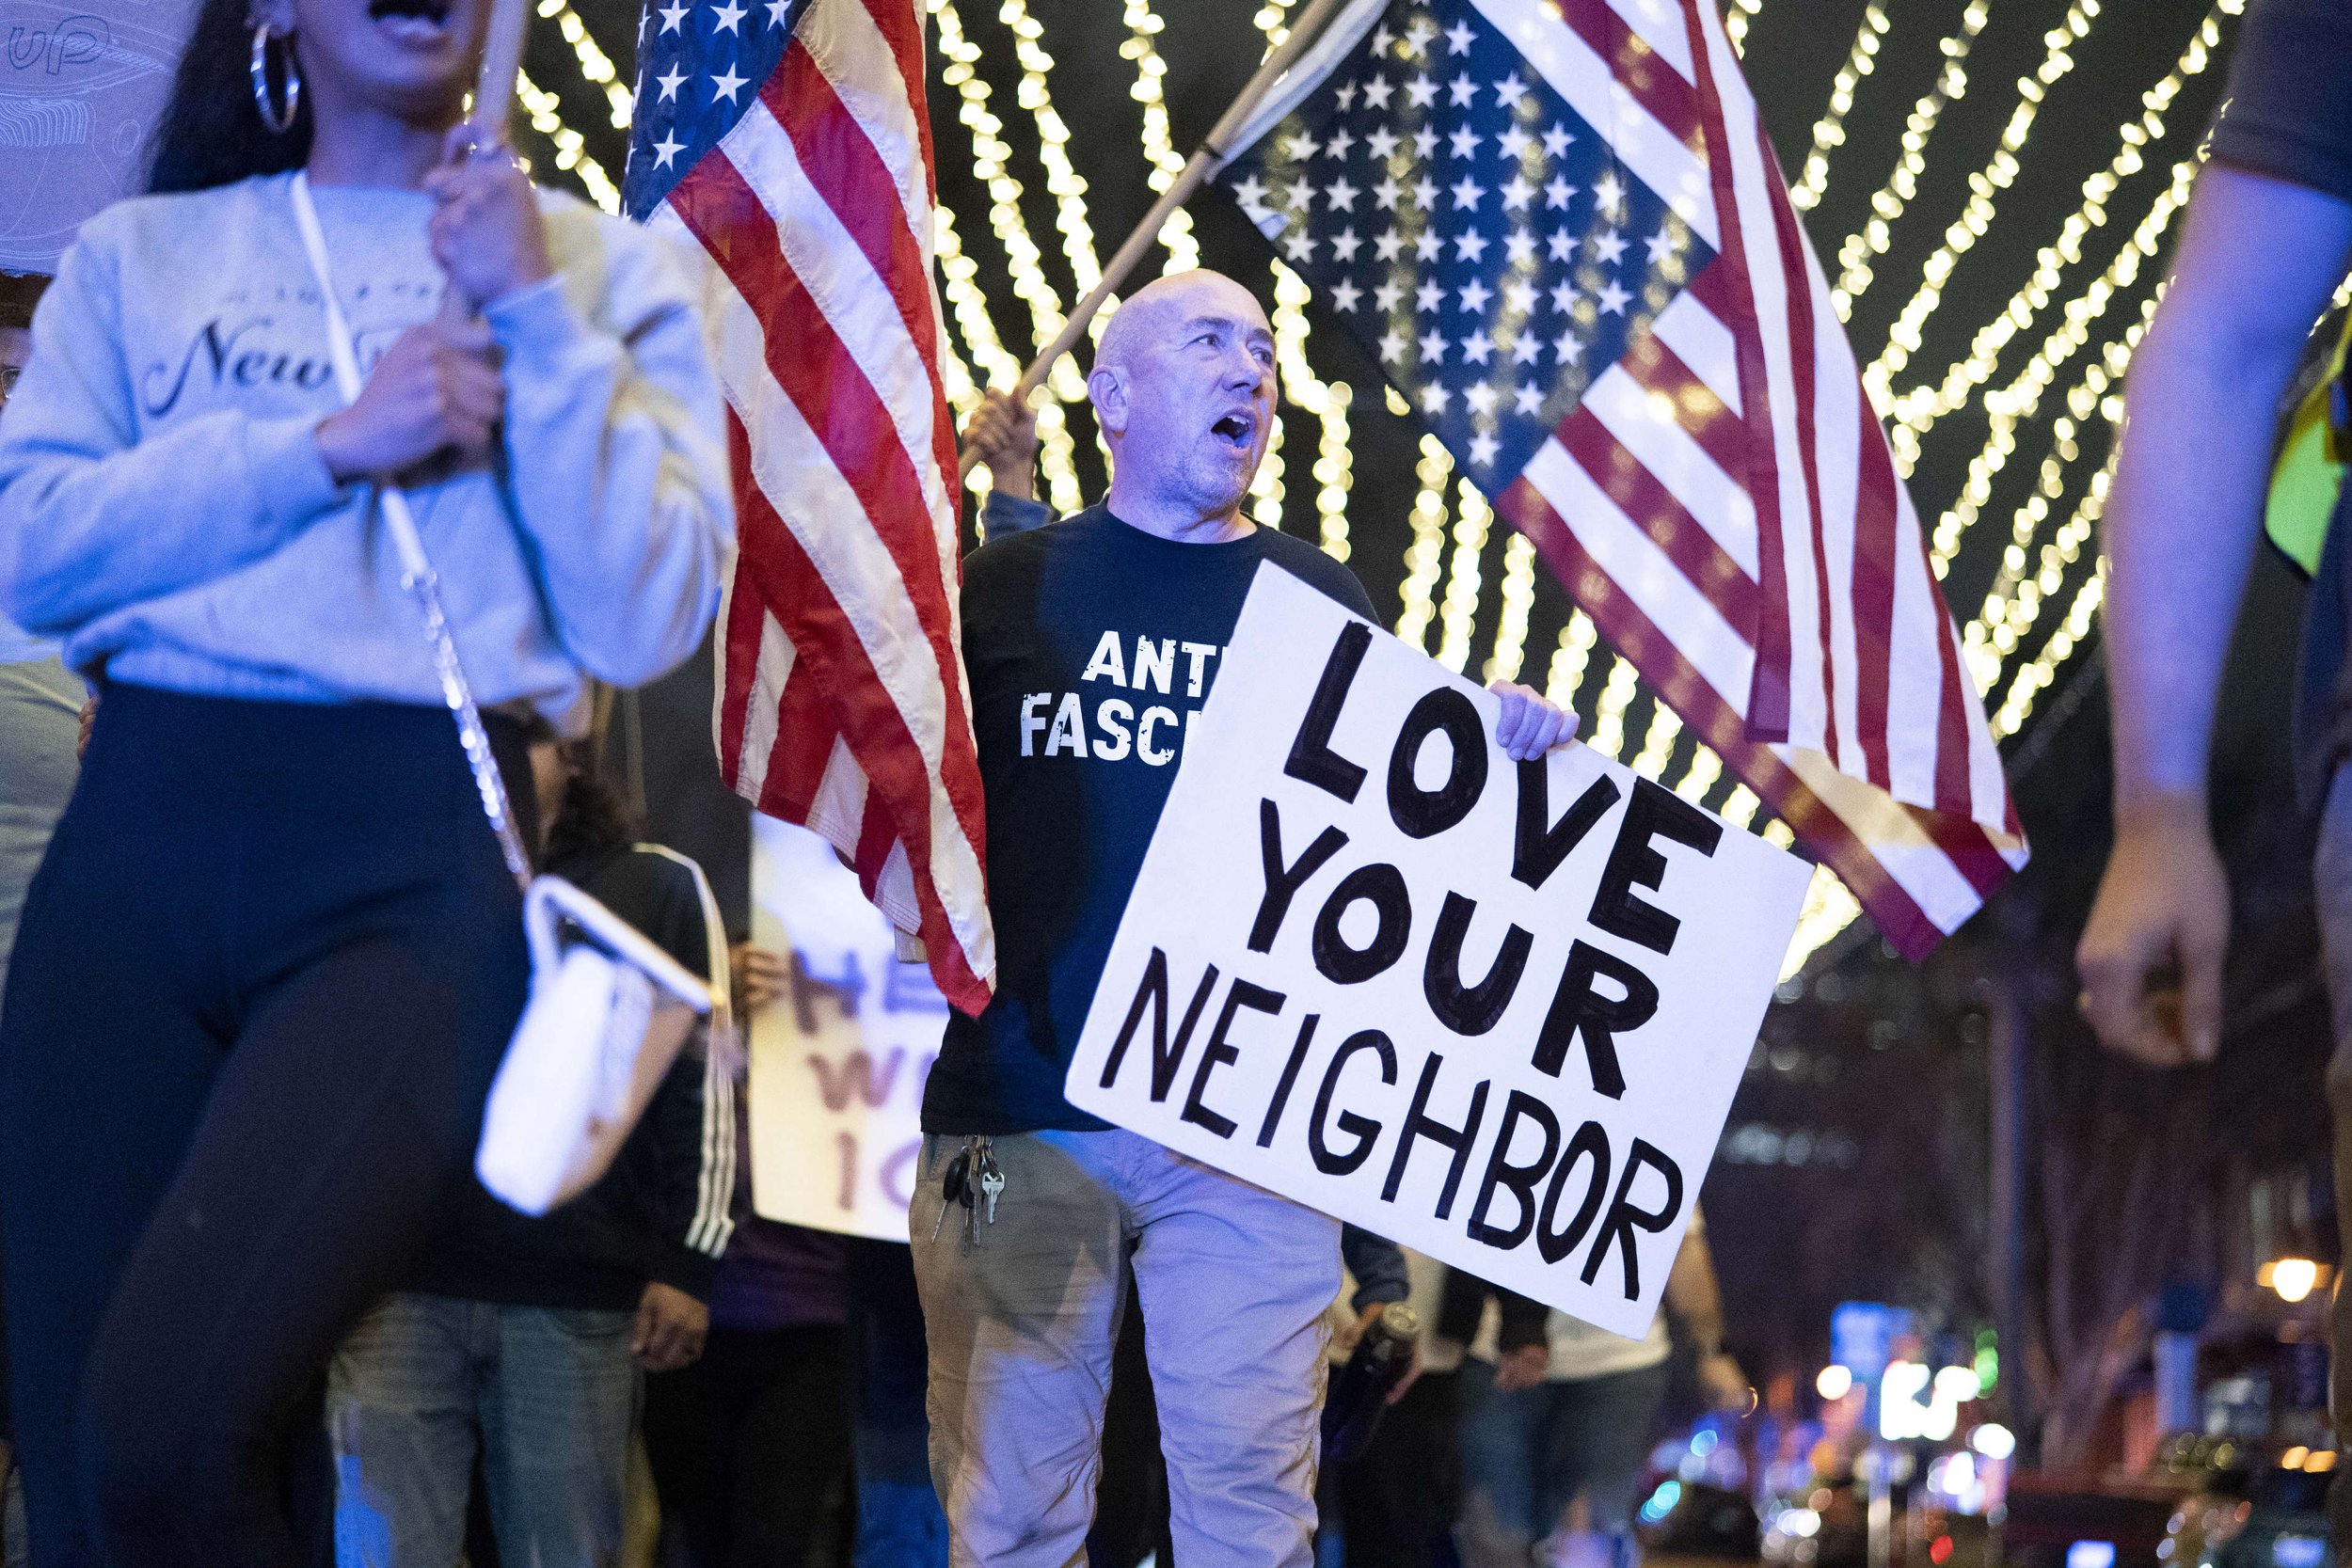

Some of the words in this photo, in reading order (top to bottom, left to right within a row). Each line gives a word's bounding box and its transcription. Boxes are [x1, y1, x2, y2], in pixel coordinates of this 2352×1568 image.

[144, 319, 333, 420] New
[1081, 630, 1229, 698] ANT
[1284, 620, 1724, 956] LOVE
[1248, 797, 1659, 1101] YOUR
[1100, 946, 1684, 1302] NEIGHBOR
